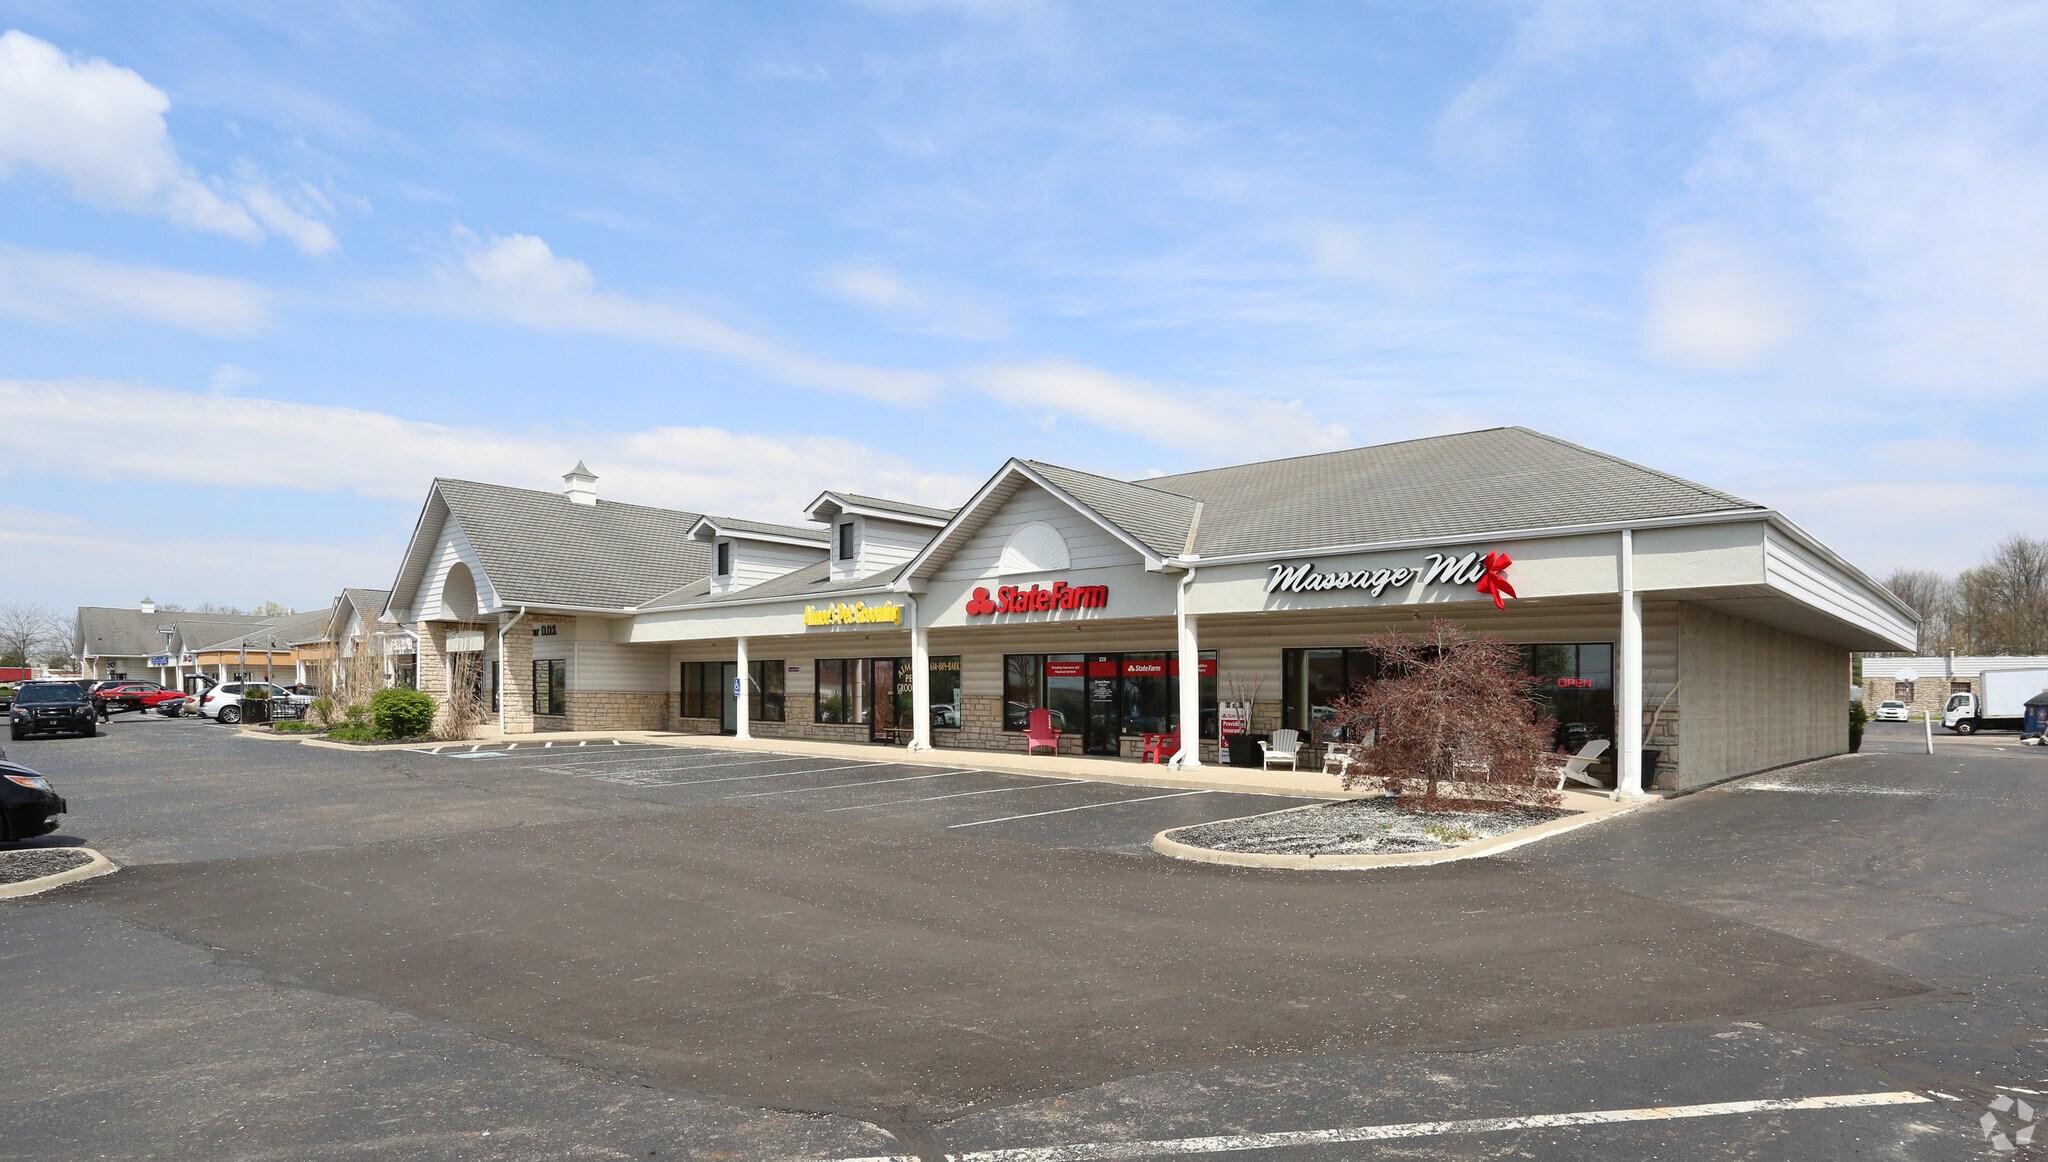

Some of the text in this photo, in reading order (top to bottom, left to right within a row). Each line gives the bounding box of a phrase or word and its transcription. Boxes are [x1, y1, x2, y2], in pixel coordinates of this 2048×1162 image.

[1266, 551, 1488, 598] Massage Mi
[804, 600, 903, 625] Aimee's Pet Grooming
[897, 662, 912, 679] AIM
[1557, 677, 1593, 688] OPEN
